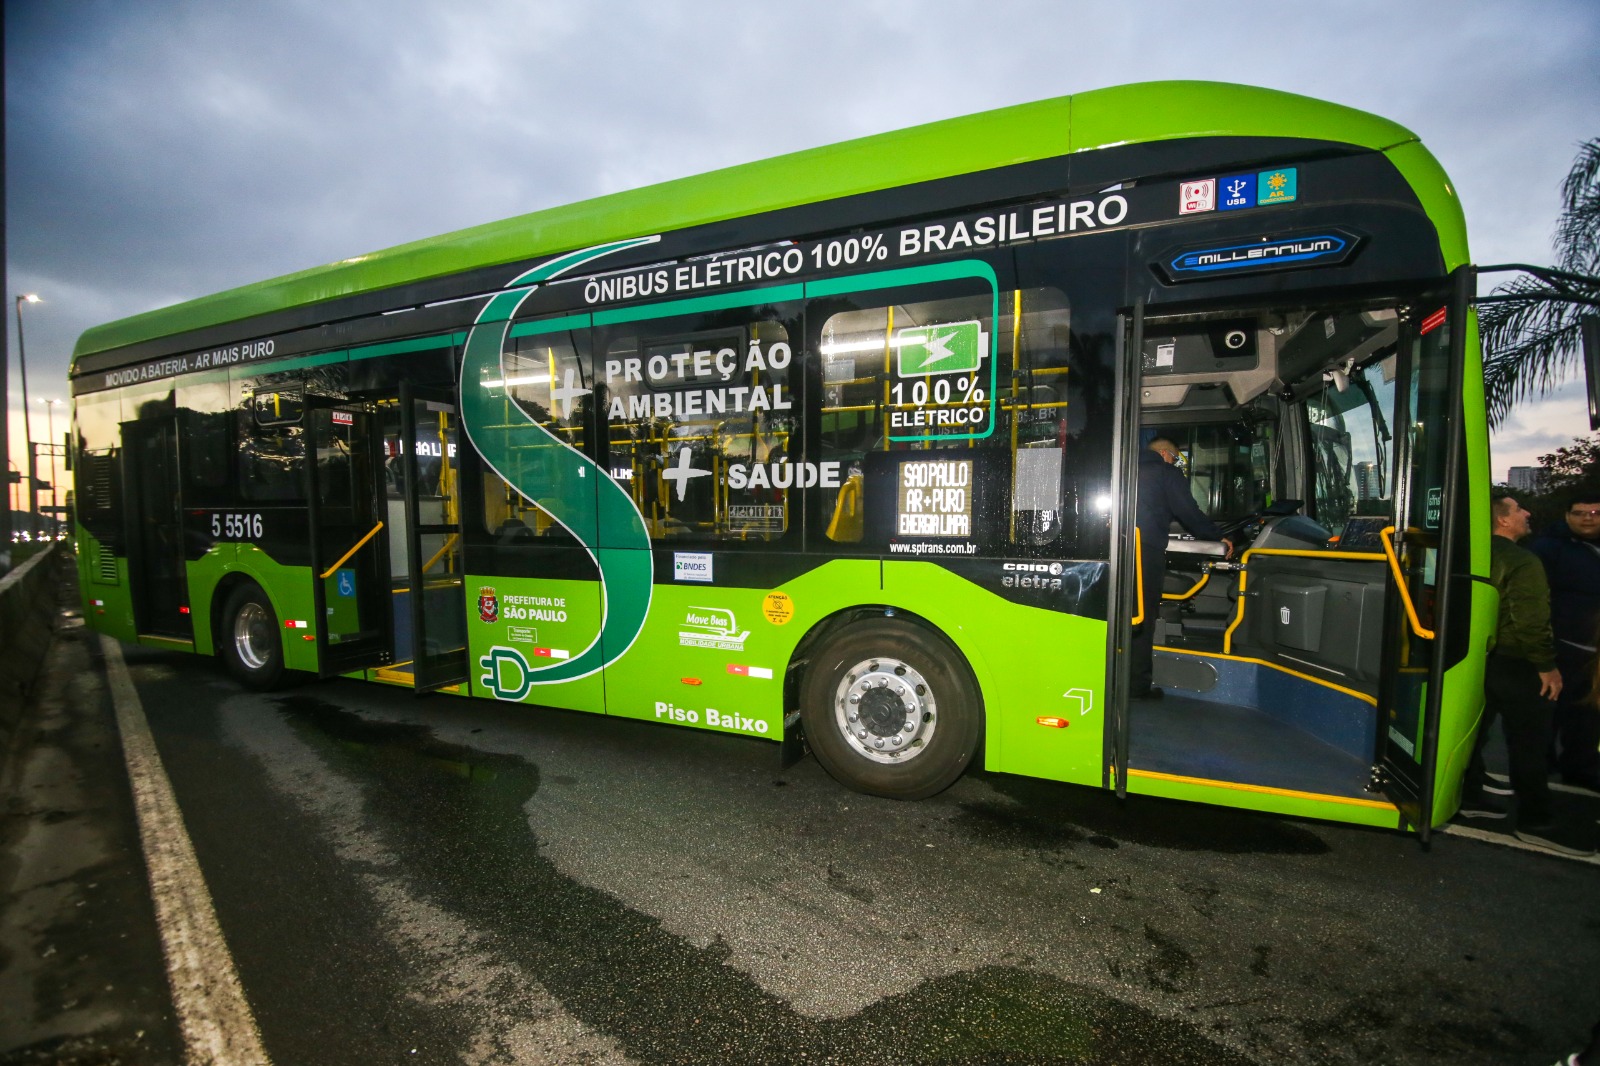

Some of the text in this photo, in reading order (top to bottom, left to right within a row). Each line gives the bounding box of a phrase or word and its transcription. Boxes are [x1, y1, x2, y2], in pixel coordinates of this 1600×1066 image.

[1226, 198, 1246, 206] USB
[1269, 190, 1284, 198] AR
[584, 194, 1128, 304] ÔNIBUS ELÉTRICO 100% BRASILEIRO
[105, 368, 139, 387] MOVIDO
[140, 367, 147, 380] A
[148, 358, 188, 378] BATERIA
[195, 354, 210, 370] AR
[212, 347, 239, 365] MAIS
[241, 340, 275, 360] PURO
[605, 339, 792, 384] PROTEÇÃO
[891, 376, 985, 407] 100%
[608, 384, 792, 420] AMBIENTAL
[891, 407, 984, 427] ELÉTRICO
[728, 456, 841, 489] SAÚDE
[928, 462, 968, 487] PAULO
[906, 488, 923, 512] AR
[932, 488, 965, 512] PURO
[212, 513, 263, 538] 5 5516
[940, 514, 969, 535] LIMPA
[889, 541, 977, 555] www.sptrans.com.br
[683, 562, 707, 571] BNDES
[1002, 563, 1049, 572] CAIO
[1001, 574, 1062, 589] eletra
[503, 595, 566, 608] PREFEITURA DE
[503, 605, 568, 623] SÃO PAULO
[686, 613, 728, 627] Move Buss
[680, 637, 744, 651] MOBILIDADE URBANA
[655, 701, 769, 734] Piso Baixo
